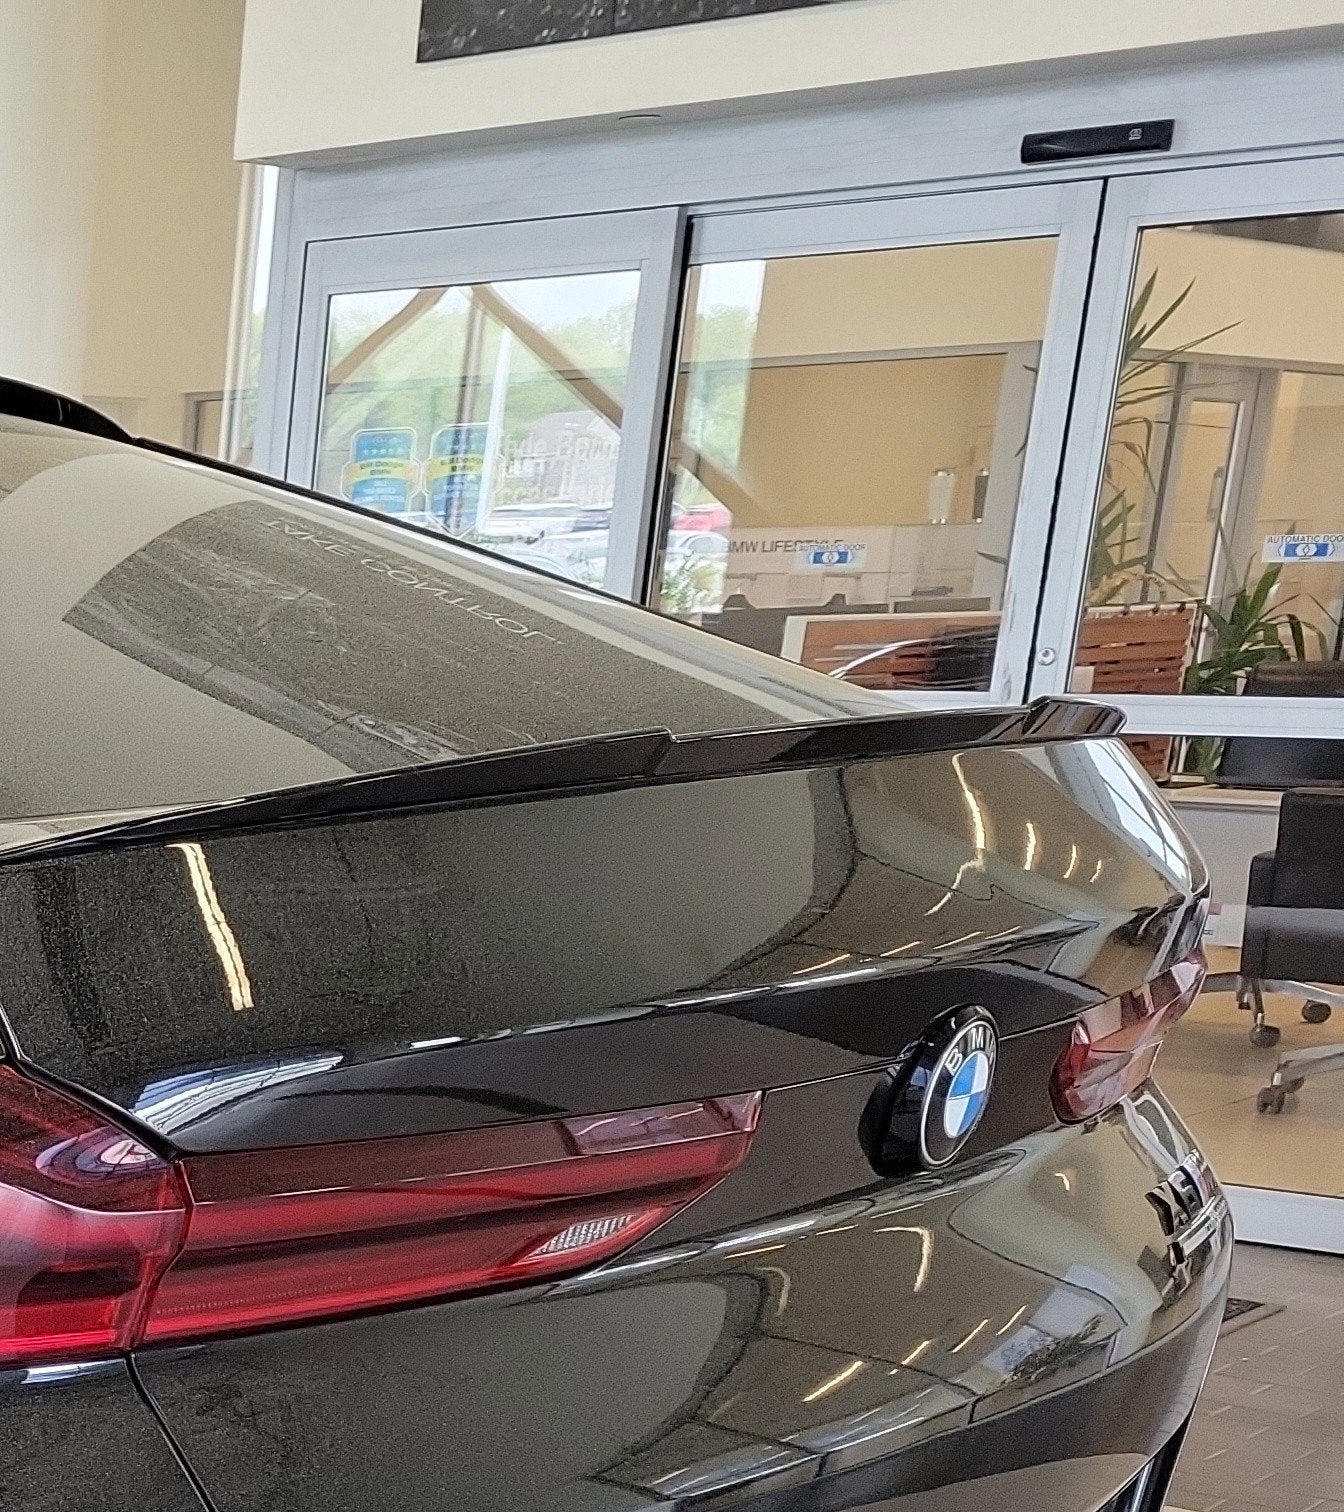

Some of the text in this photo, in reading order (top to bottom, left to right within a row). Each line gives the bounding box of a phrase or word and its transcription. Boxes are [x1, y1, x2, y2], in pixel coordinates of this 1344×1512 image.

[762, 539, 844, 553] LIFES
[1267, 535, 1320, 544] AUTOMATIC
[945, 1026, 996, 1077] BMW
